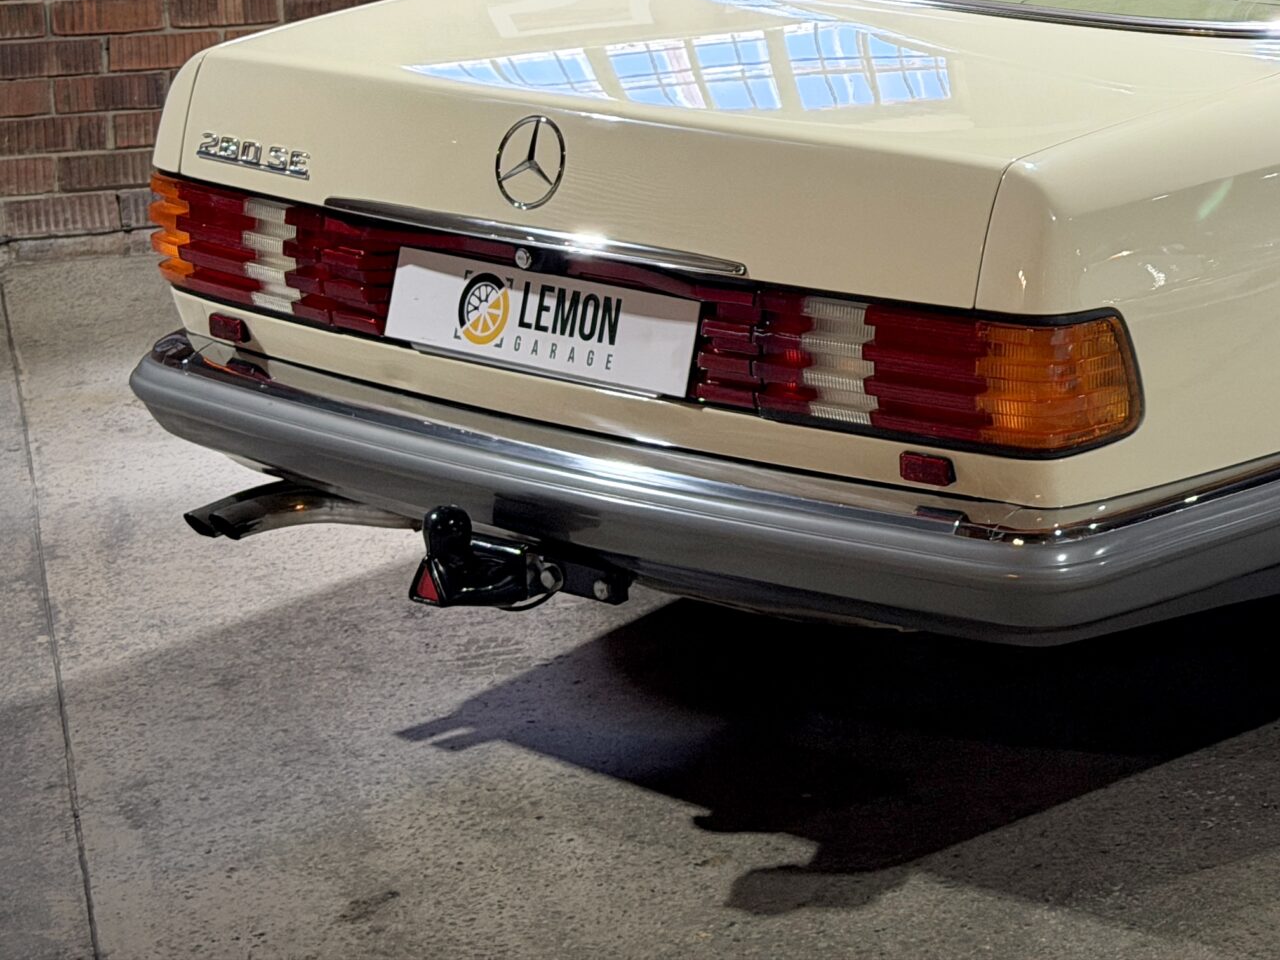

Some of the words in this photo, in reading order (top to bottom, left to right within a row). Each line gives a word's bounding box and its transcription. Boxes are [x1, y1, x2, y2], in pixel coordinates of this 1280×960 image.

[198, 132, 263, 164] 280
[267, 146, 311, 173] SE
[518, 281, 623, 346] LEMON
[513, 335, 614, 370] GARAGE
